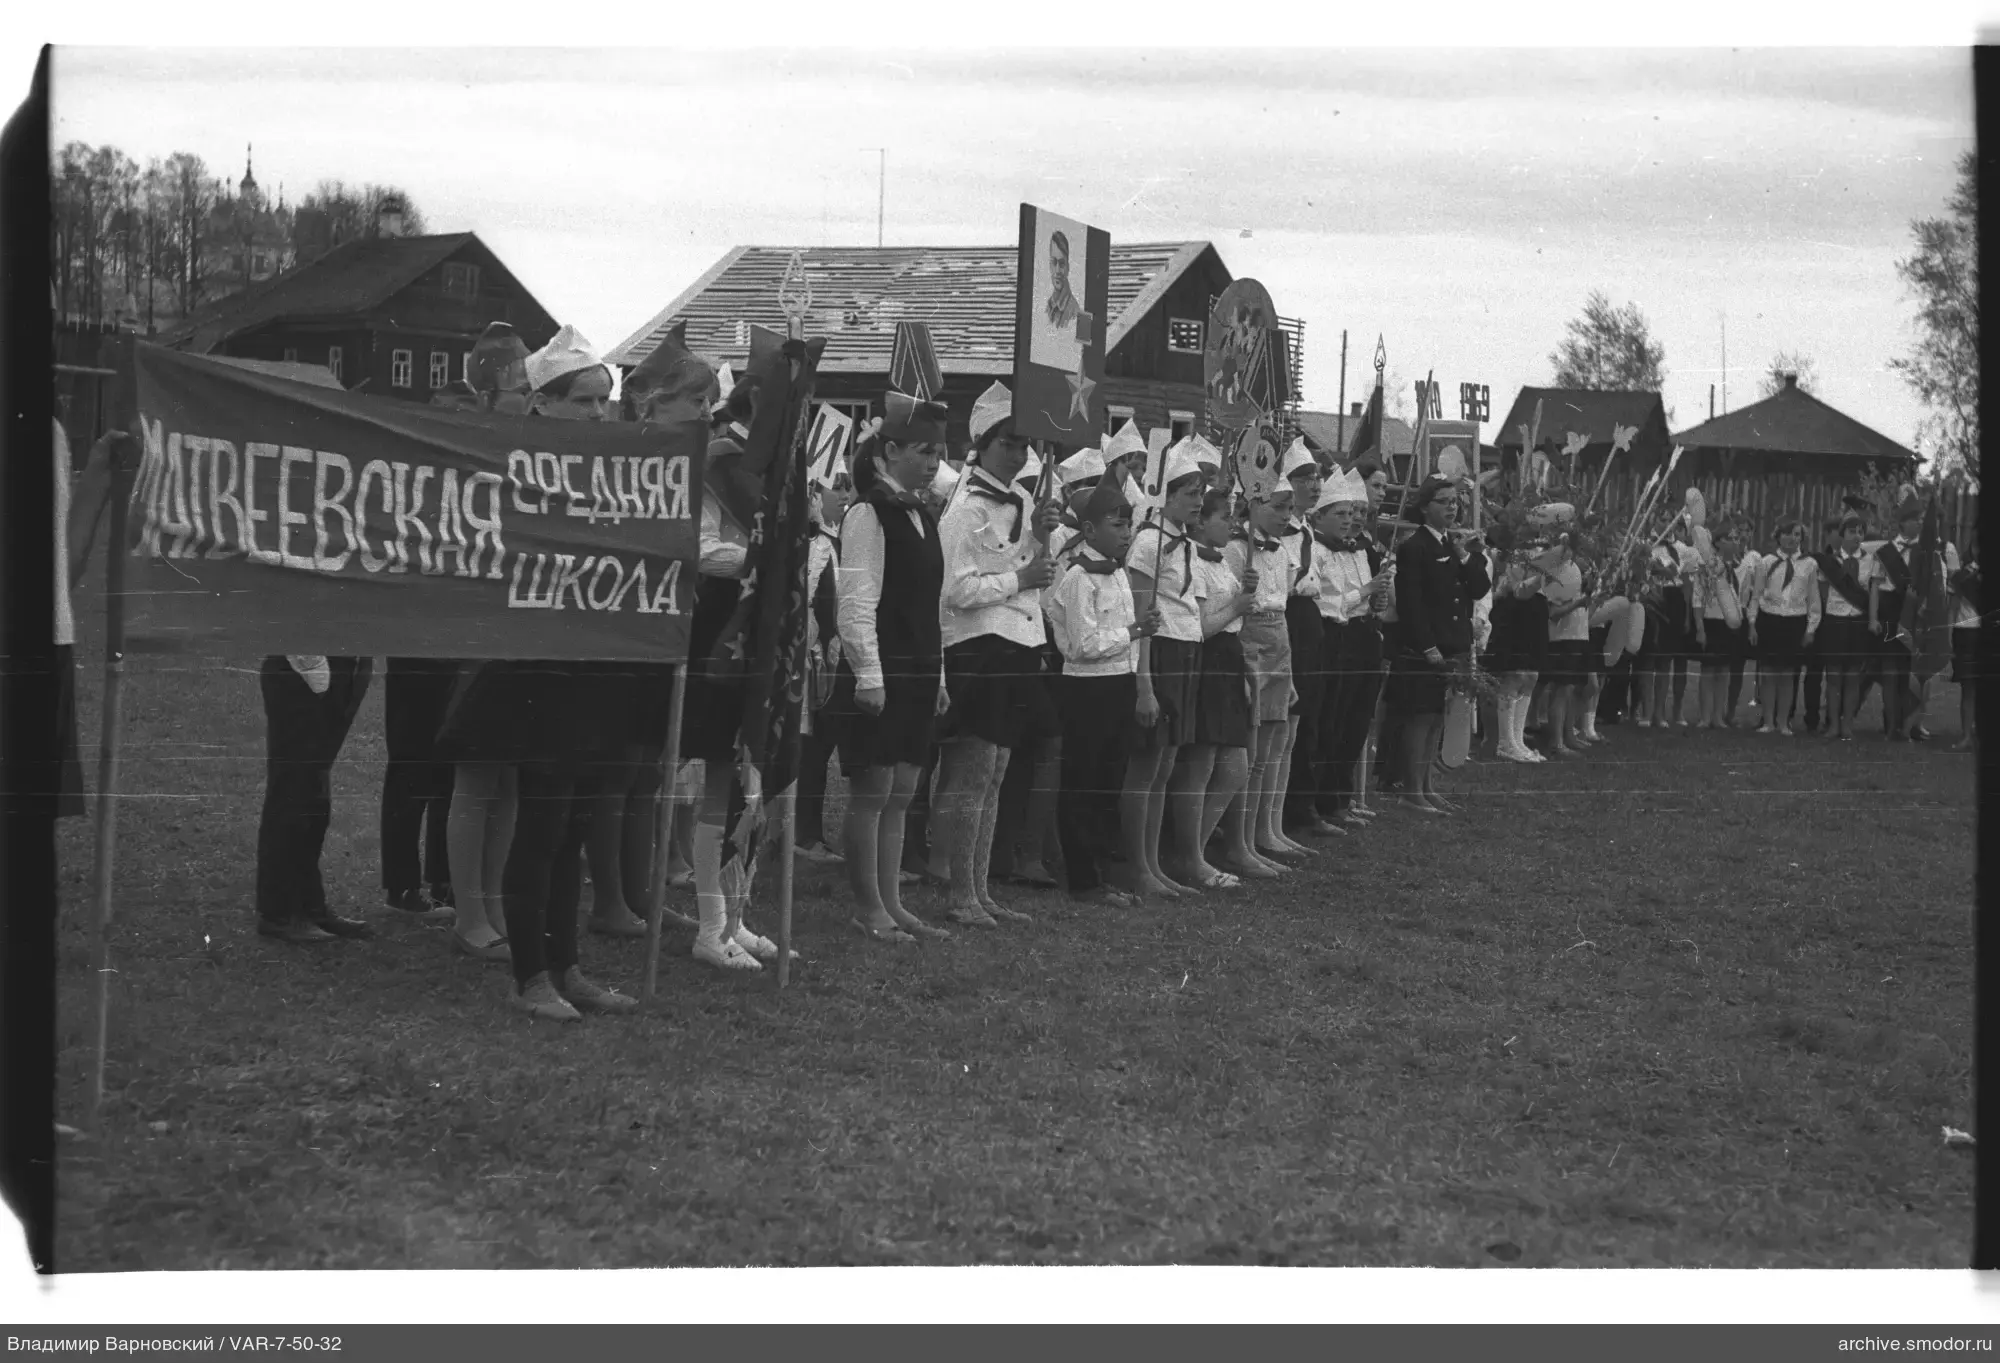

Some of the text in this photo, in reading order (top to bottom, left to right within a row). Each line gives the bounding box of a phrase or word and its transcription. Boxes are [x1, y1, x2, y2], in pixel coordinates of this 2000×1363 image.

[1459, 381, 1490, 423] 1969
[128, 412, 504, 579] МАТВЕЕВСКАЯ
[508, 449, 691, 524] СРЕДНЯЯ
[507, 552, 682, 614] ШКОЛА
